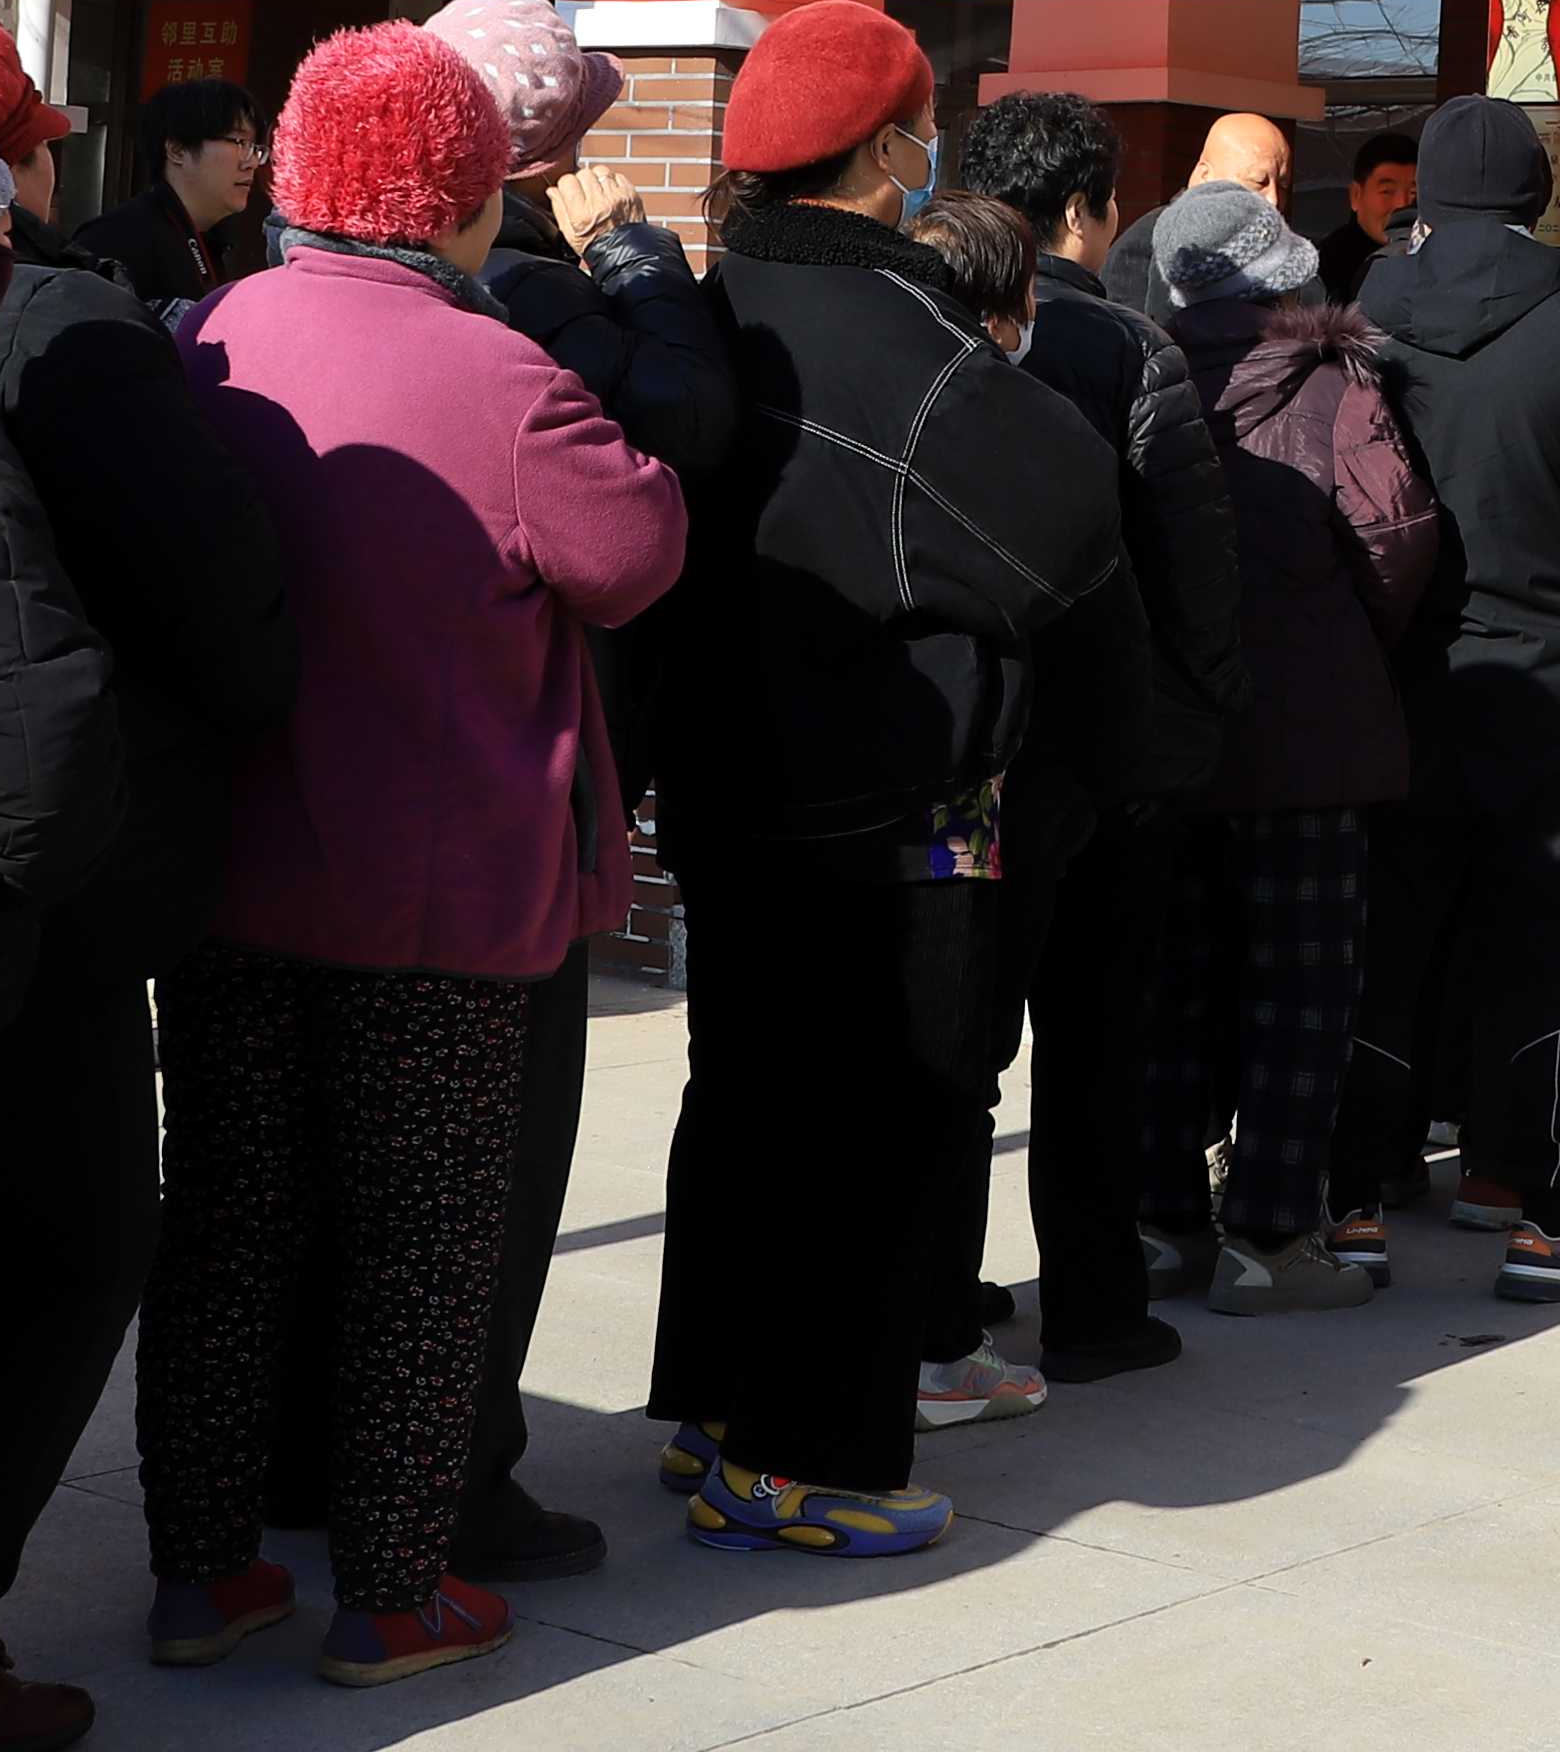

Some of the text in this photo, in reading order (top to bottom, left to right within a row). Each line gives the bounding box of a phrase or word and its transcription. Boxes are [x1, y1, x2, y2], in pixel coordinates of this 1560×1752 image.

[161, 21, 238, 46] 邻里互助
[166, 57, 225, 81] 活动室
[188, 238, 207, 274] Canon
